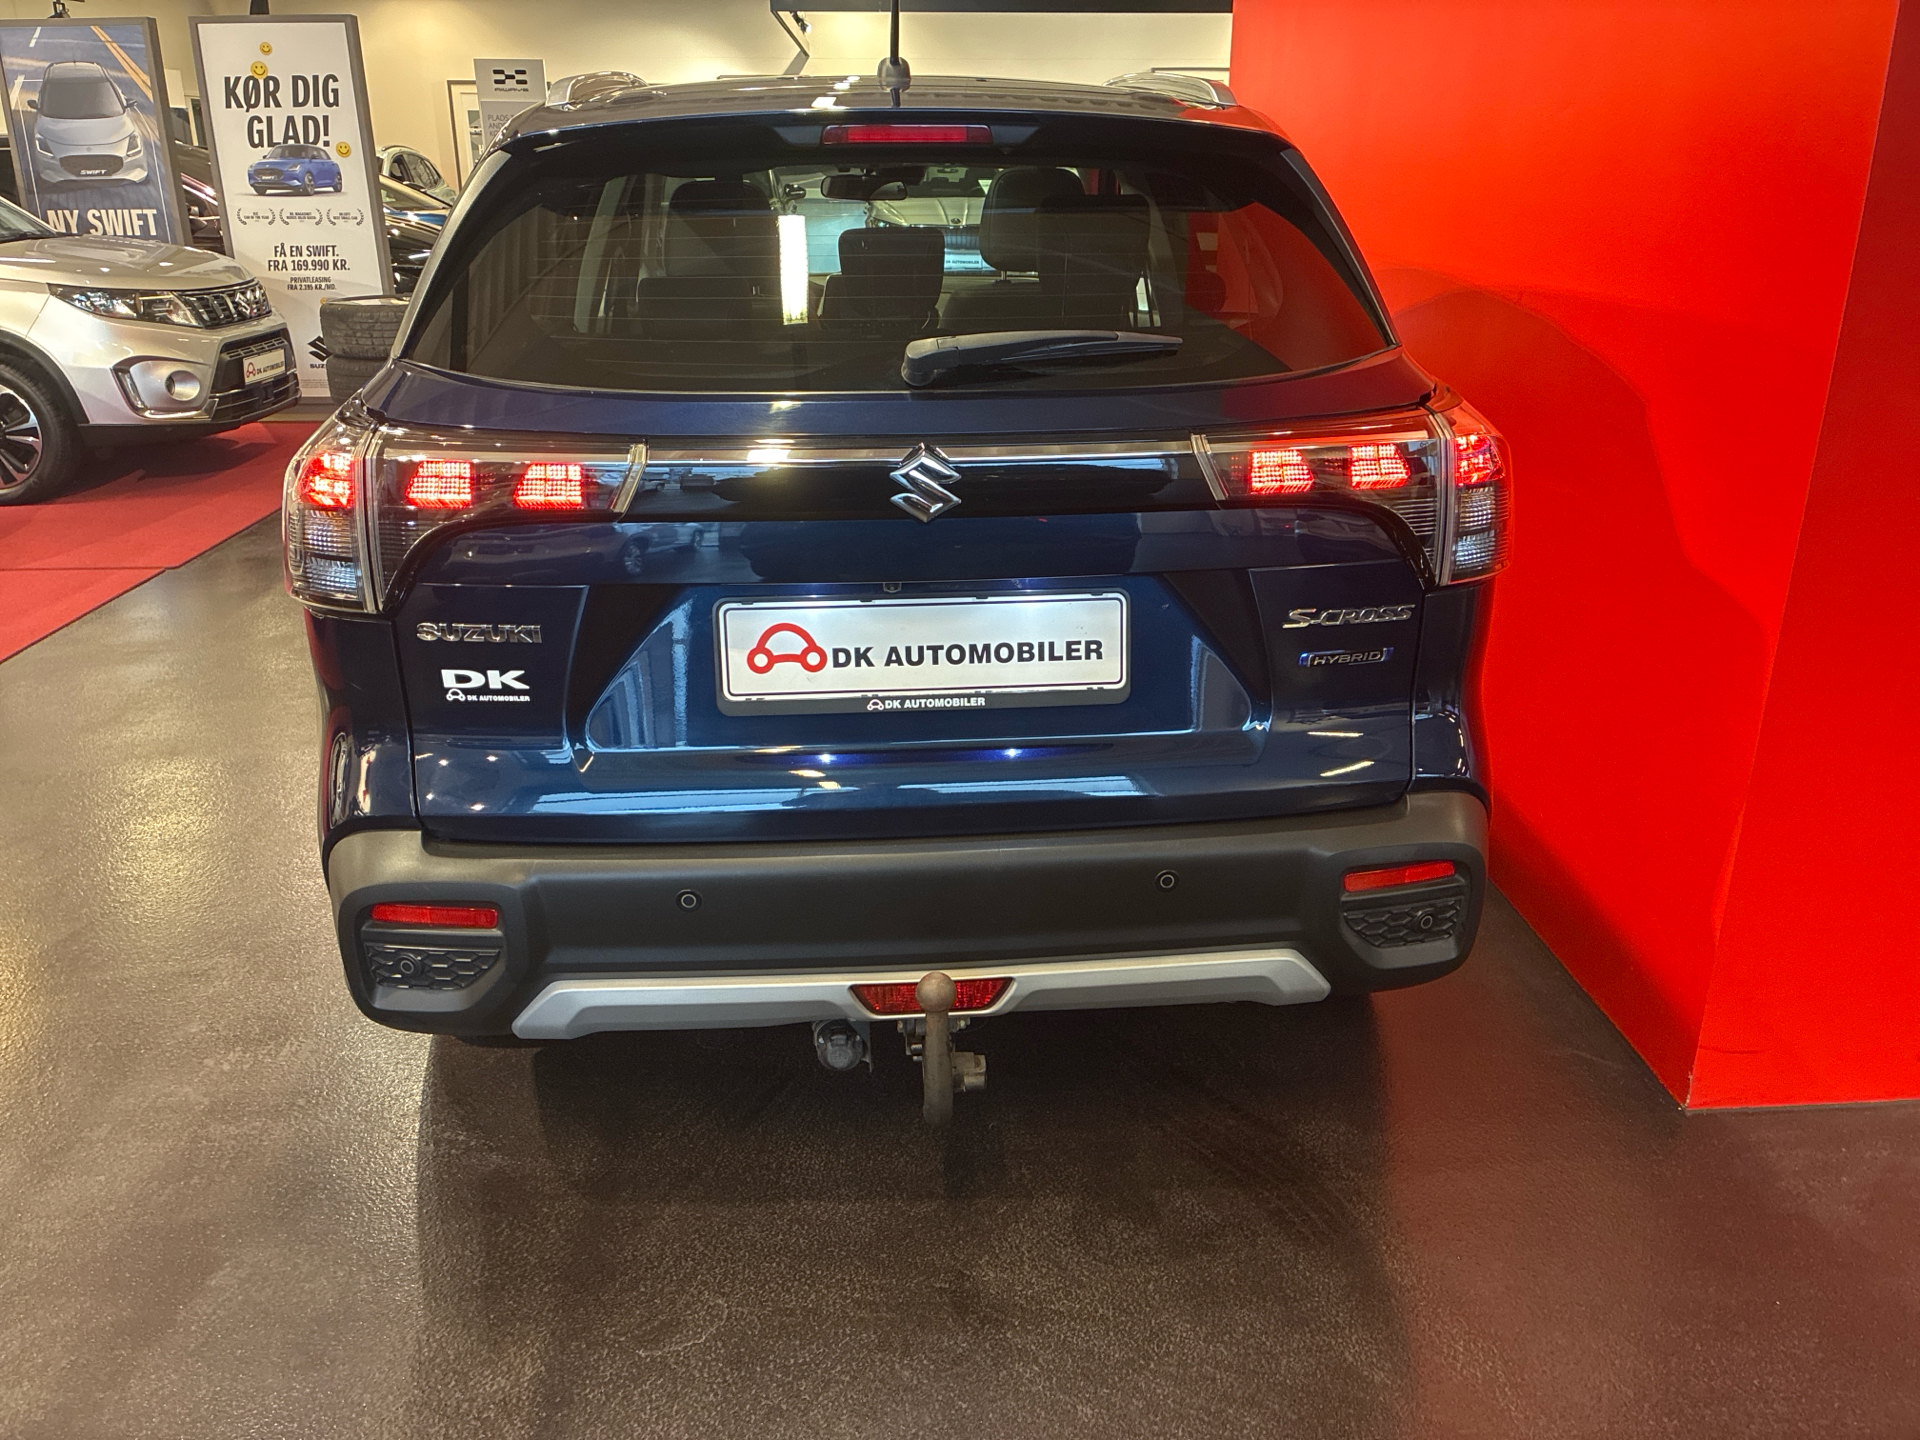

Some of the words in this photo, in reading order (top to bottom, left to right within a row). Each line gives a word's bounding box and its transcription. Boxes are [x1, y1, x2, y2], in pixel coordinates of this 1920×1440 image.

[224, 75, 282, 112] KØR
[291, 74, 340, 108] DIG
[247, 115, 331, 148] GLAD!
[47, 209, 79, 233] NY
[87, 208, 157, 236] SWIFT
[274, 242, 287, 258] FÅ
[289, 245, 303, 257] EN
[306, 244, 339, 257] SWIFT.
[267, 259, 288, 271] FRA
[291, 259, 330, 271] 169.990
[332, 258, 351, 271] KR.
[416, 622, 542, 643] SUZUKI
[832, 646, 875, 668] DK
[884, 639, 1104, 666] AUTOMOBILER
[1313, 651, 1382, 666] HYBRID
[441, 669, 530, 689] DK
[479, 694, 531, 702] AUTOMOBILER
[884, 700, 902, 709] DK
[904, 697, 986, 708] AUTOMOBILER
